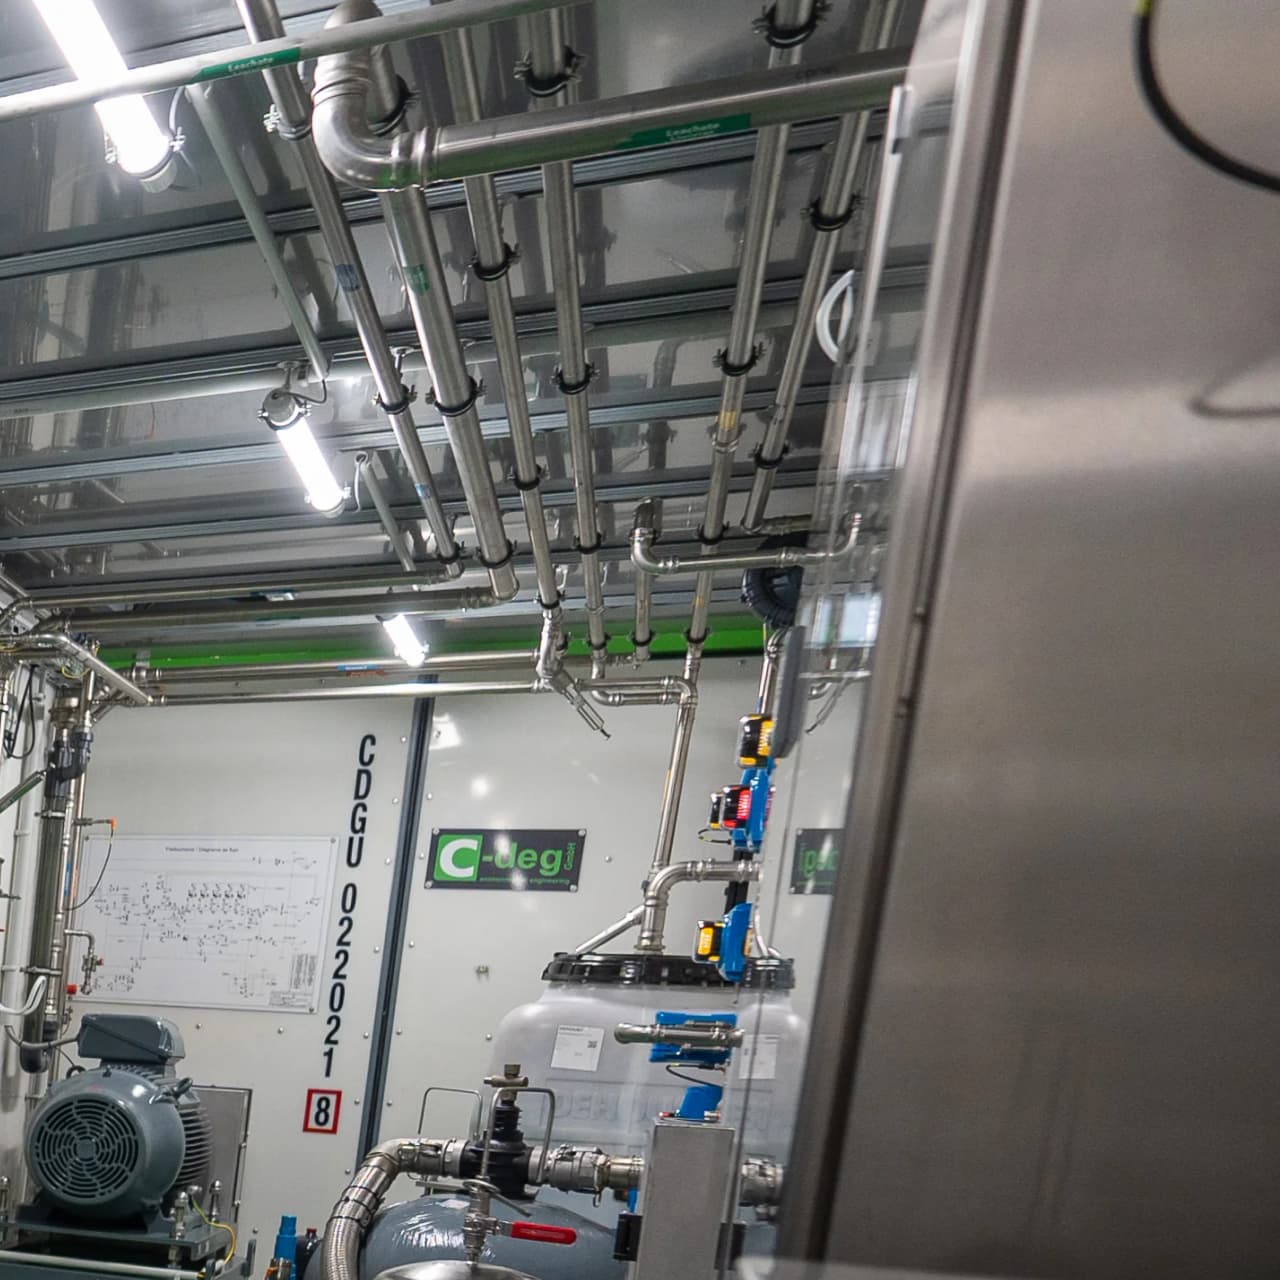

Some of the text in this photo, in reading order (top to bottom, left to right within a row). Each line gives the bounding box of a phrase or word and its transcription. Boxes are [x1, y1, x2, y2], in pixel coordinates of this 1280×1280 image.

[314, 733, 377, 1127] CDGU 022021 8
